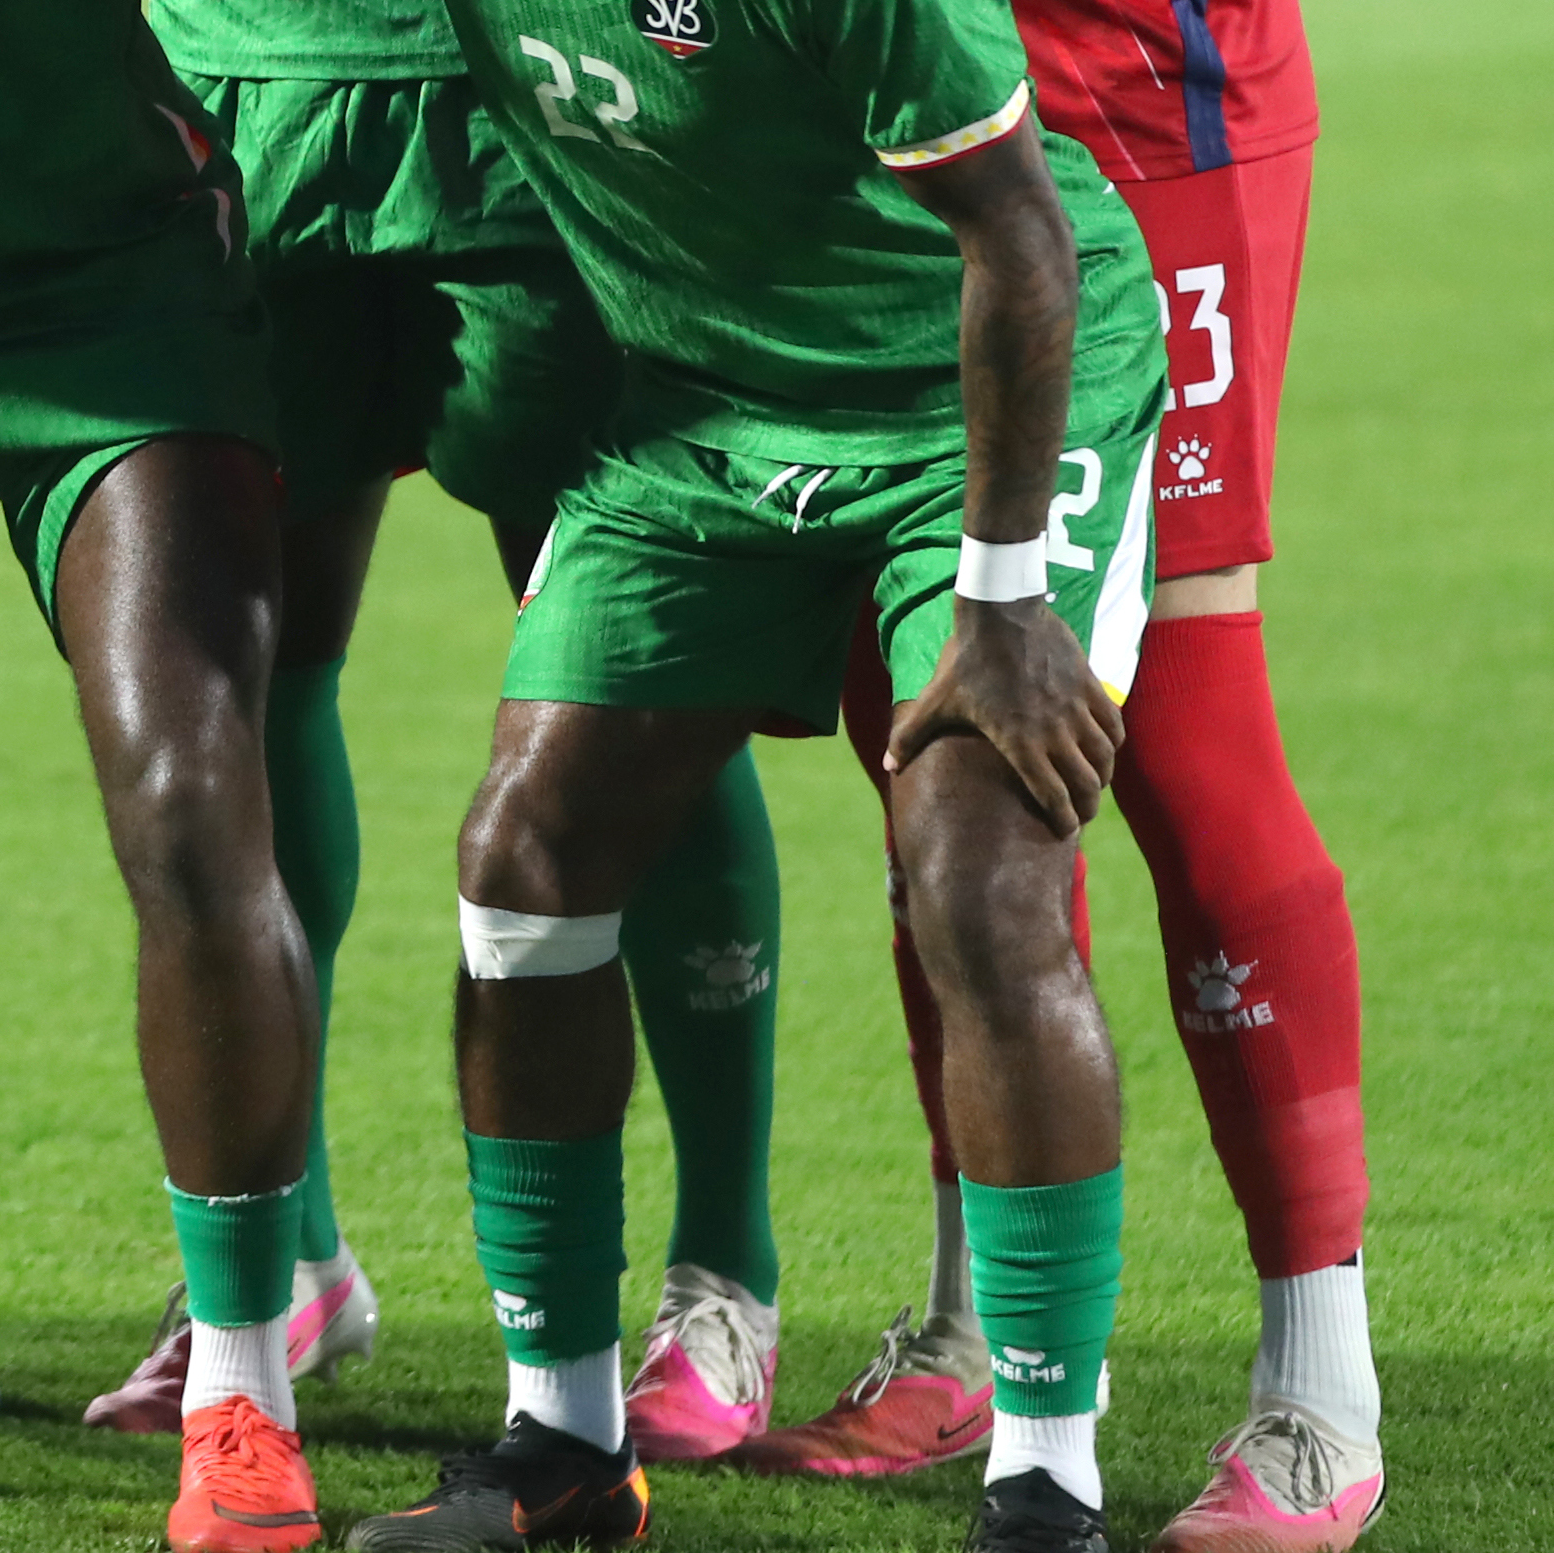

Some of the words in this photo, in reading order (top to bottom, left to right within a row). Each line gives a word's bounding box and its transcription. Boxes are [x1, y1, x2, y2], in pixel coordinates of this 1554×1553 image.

[518, 34, 668, 164] 22
[689, 965, 770, 1010] KELME
[991, 1354, 1066, 1383] KELME
